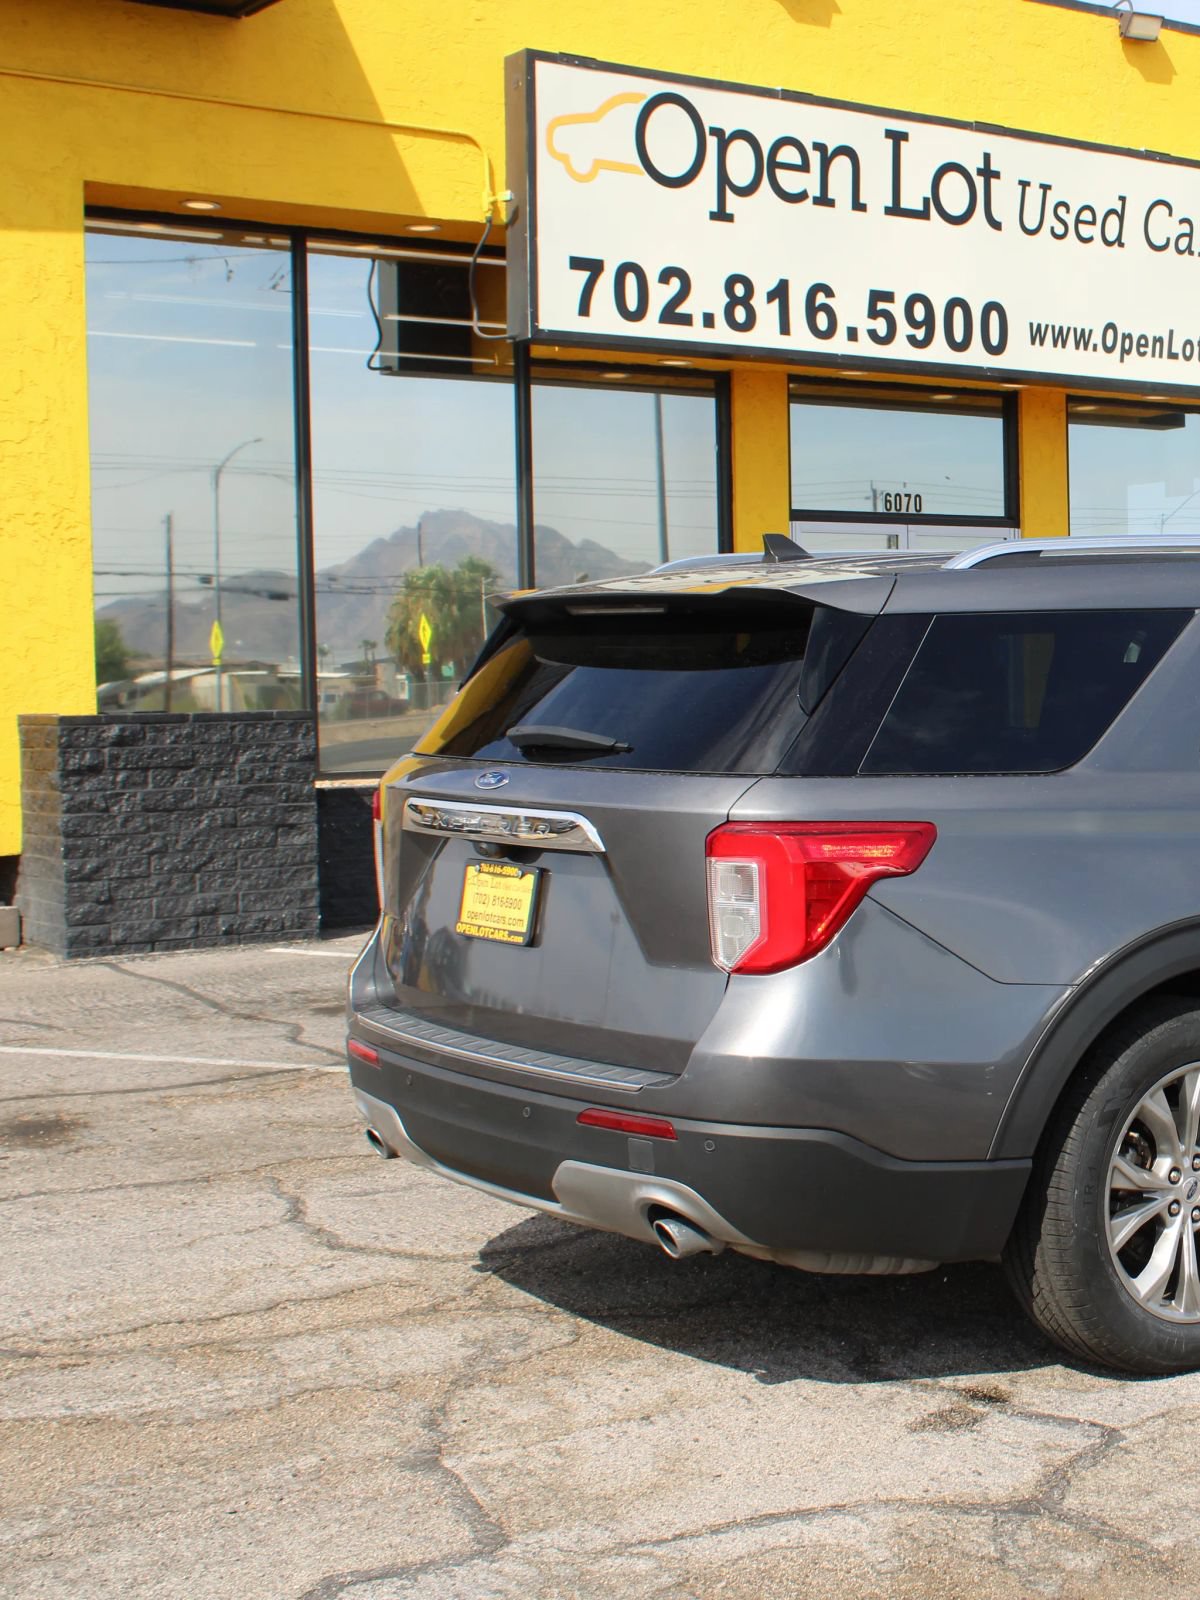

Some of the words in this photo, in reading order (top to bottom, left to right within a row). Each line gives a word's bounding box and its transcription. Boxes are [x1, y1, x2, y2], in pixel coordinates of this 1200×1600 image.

[635, 91, 868, 223] Open
[884, 128, 1003, 232] Lot
[1017, 179, 1127, 248] Used
[568, 255, 1009, 356] 702.816.5900
[884, 492, 922, 513] 6070
[472, 892, 491, 907] (702)
[466, 910, 524, 928] openlotcars.com
[456, 922, 524, 943] OPENLOTCARS.com
